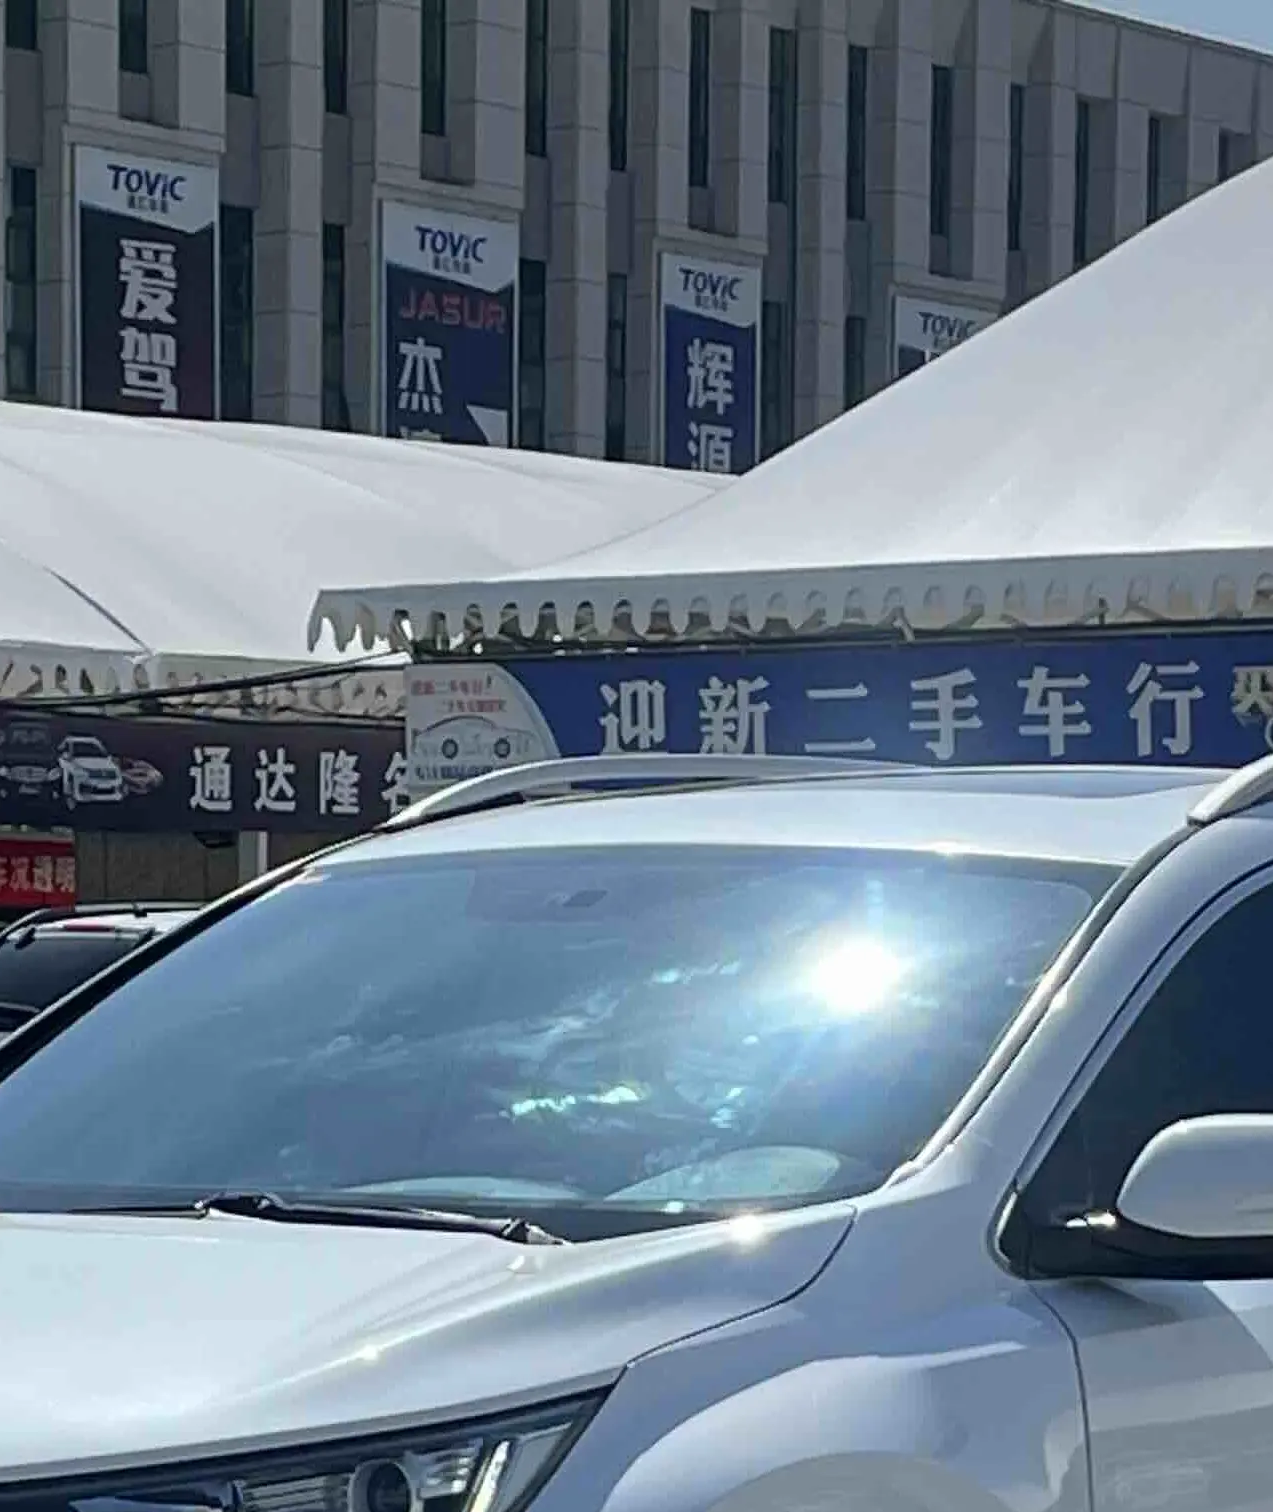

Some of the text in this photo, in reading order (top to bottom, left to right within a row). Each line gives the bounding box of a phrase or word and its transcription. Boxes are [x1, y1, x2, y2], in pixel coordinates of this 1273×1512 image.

[598, 659, 1205, 758] 迎新二手车行
